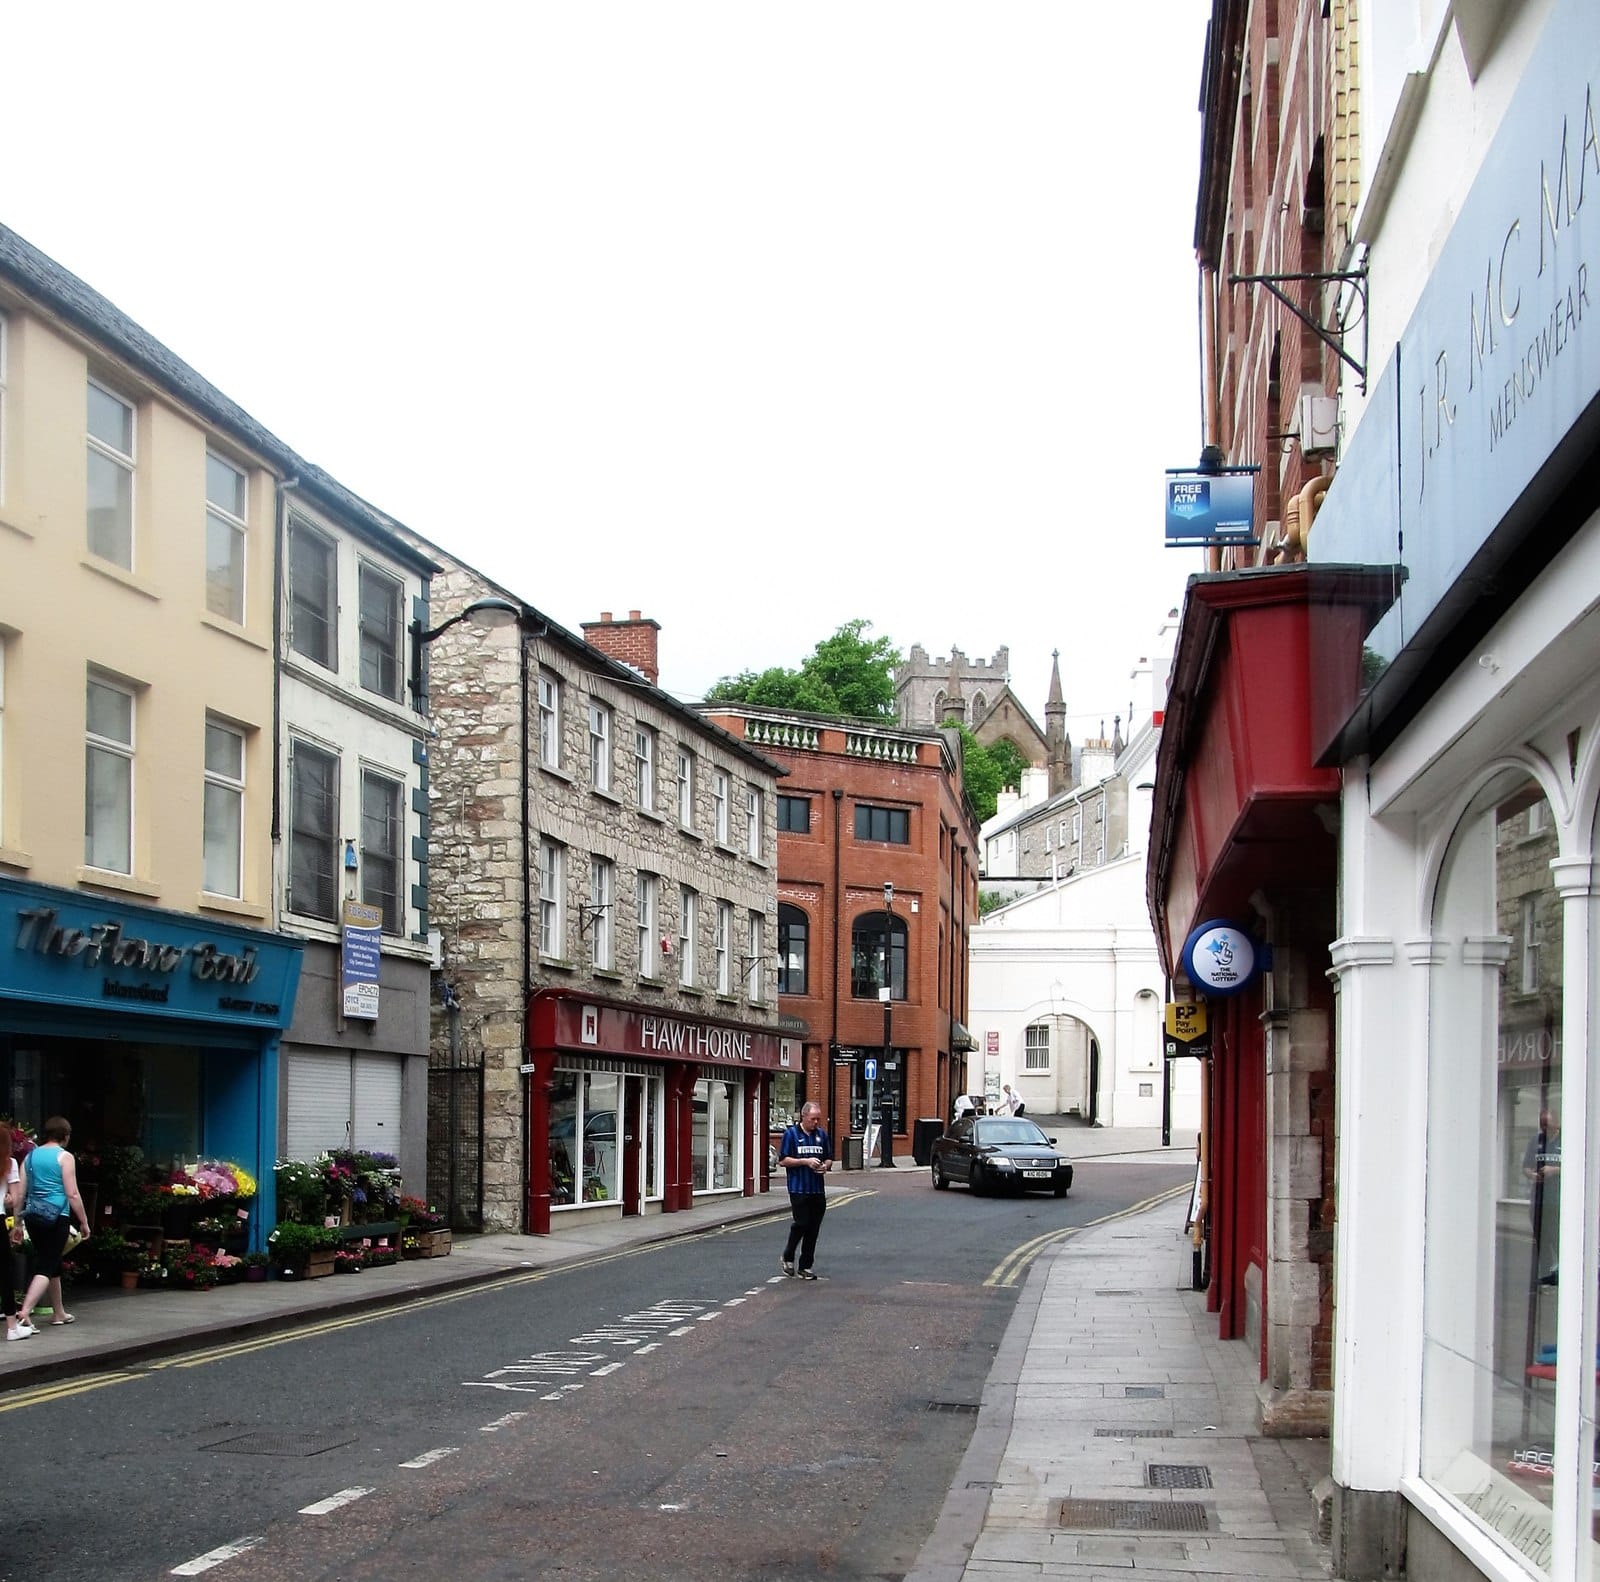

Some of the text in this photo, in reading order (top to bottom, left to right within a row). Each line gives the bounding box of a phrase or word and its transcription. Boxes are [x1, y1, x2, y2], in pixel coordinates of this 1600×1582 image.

[1489, 262, 1592, 454] MENSWEAR
[1174, 483, 1202, 494] FREE
[1174, 494, 1197, 504] ATM
[15, 905, 86, 957] The
[1176, 1020, 1191, 1028] Pay
[641, 1017, 752, 1062] HAWTHORNE
